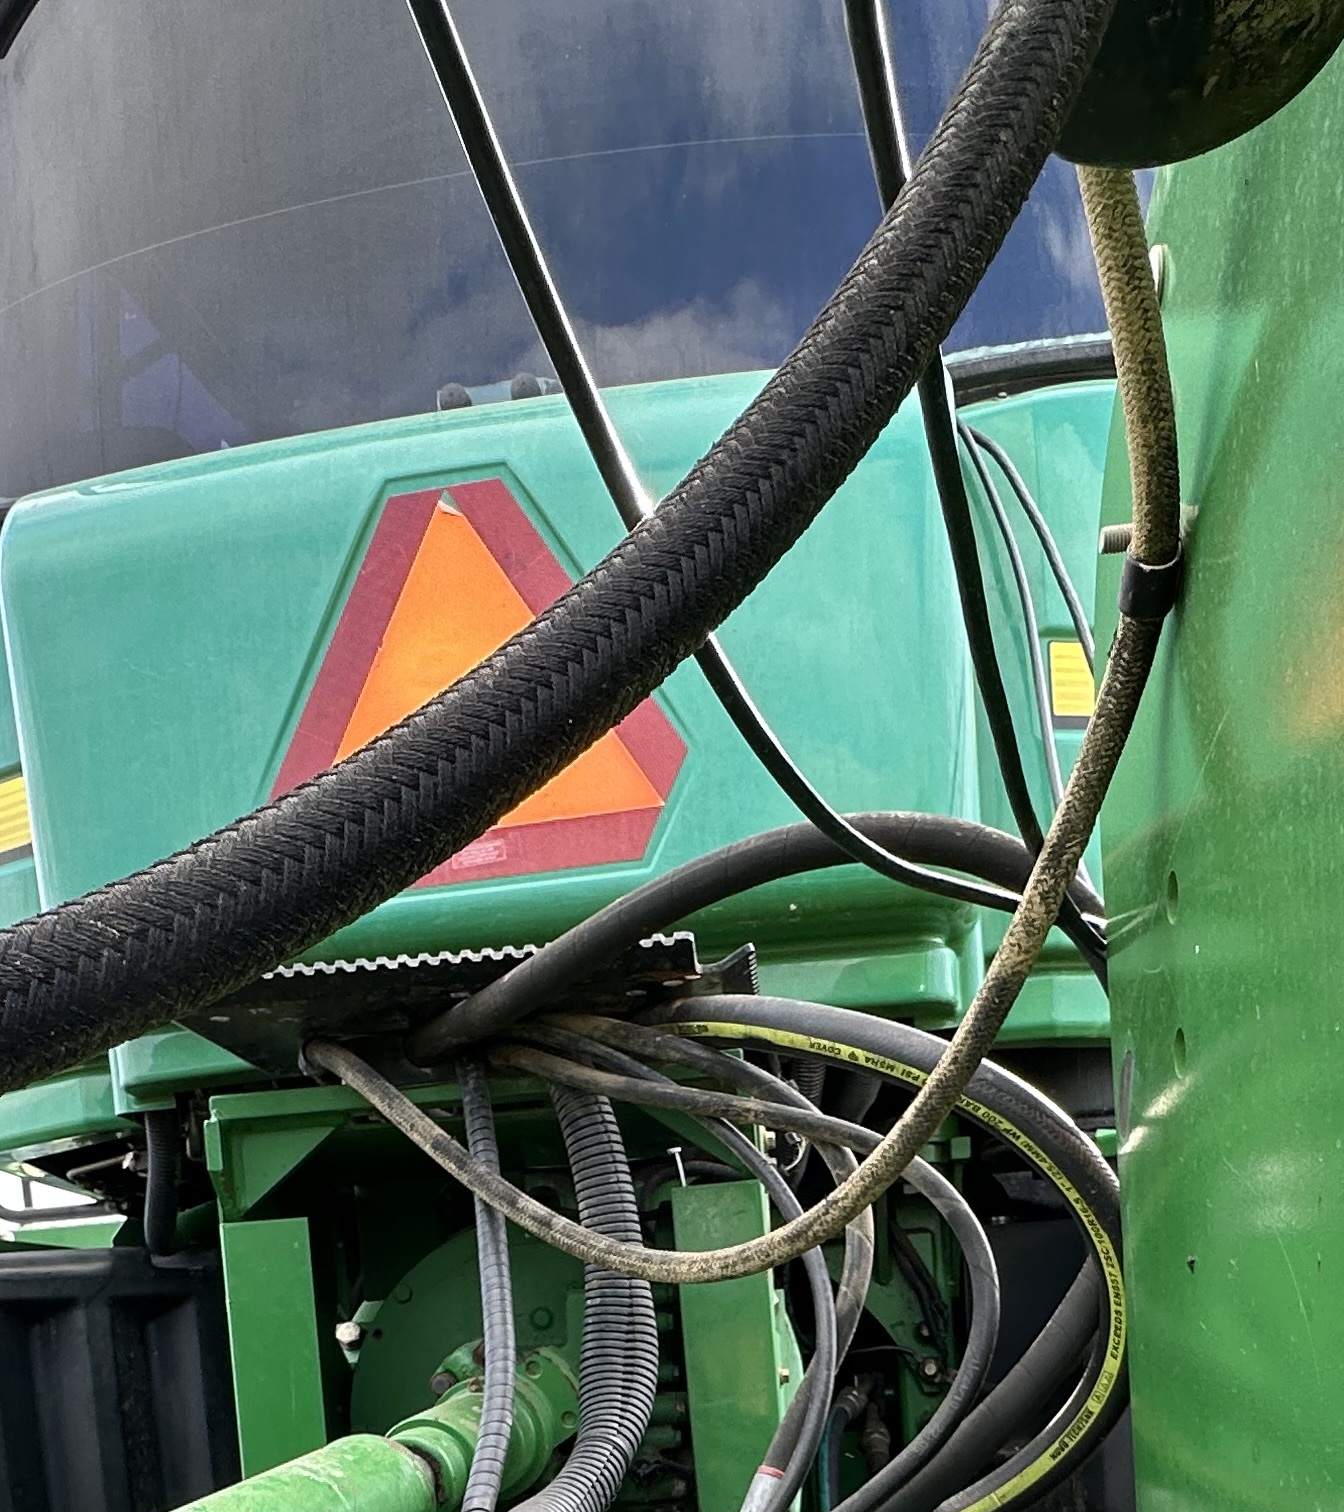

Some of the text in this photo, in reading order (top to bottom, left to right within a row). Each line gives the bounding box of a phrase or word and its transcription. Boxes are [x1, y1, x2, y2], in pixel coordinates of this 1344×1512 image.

[809, 1041, 842, 1055] COVER
[864, 1055, 896, 1072] MSHA
[900, 1067, 921, 1082] PSI
[981, 1111, 1003, 1128] 200
[1002, 1127, 1021, 1141] WP
[1110, 1309, 1123, 1361] EXCEEDS
